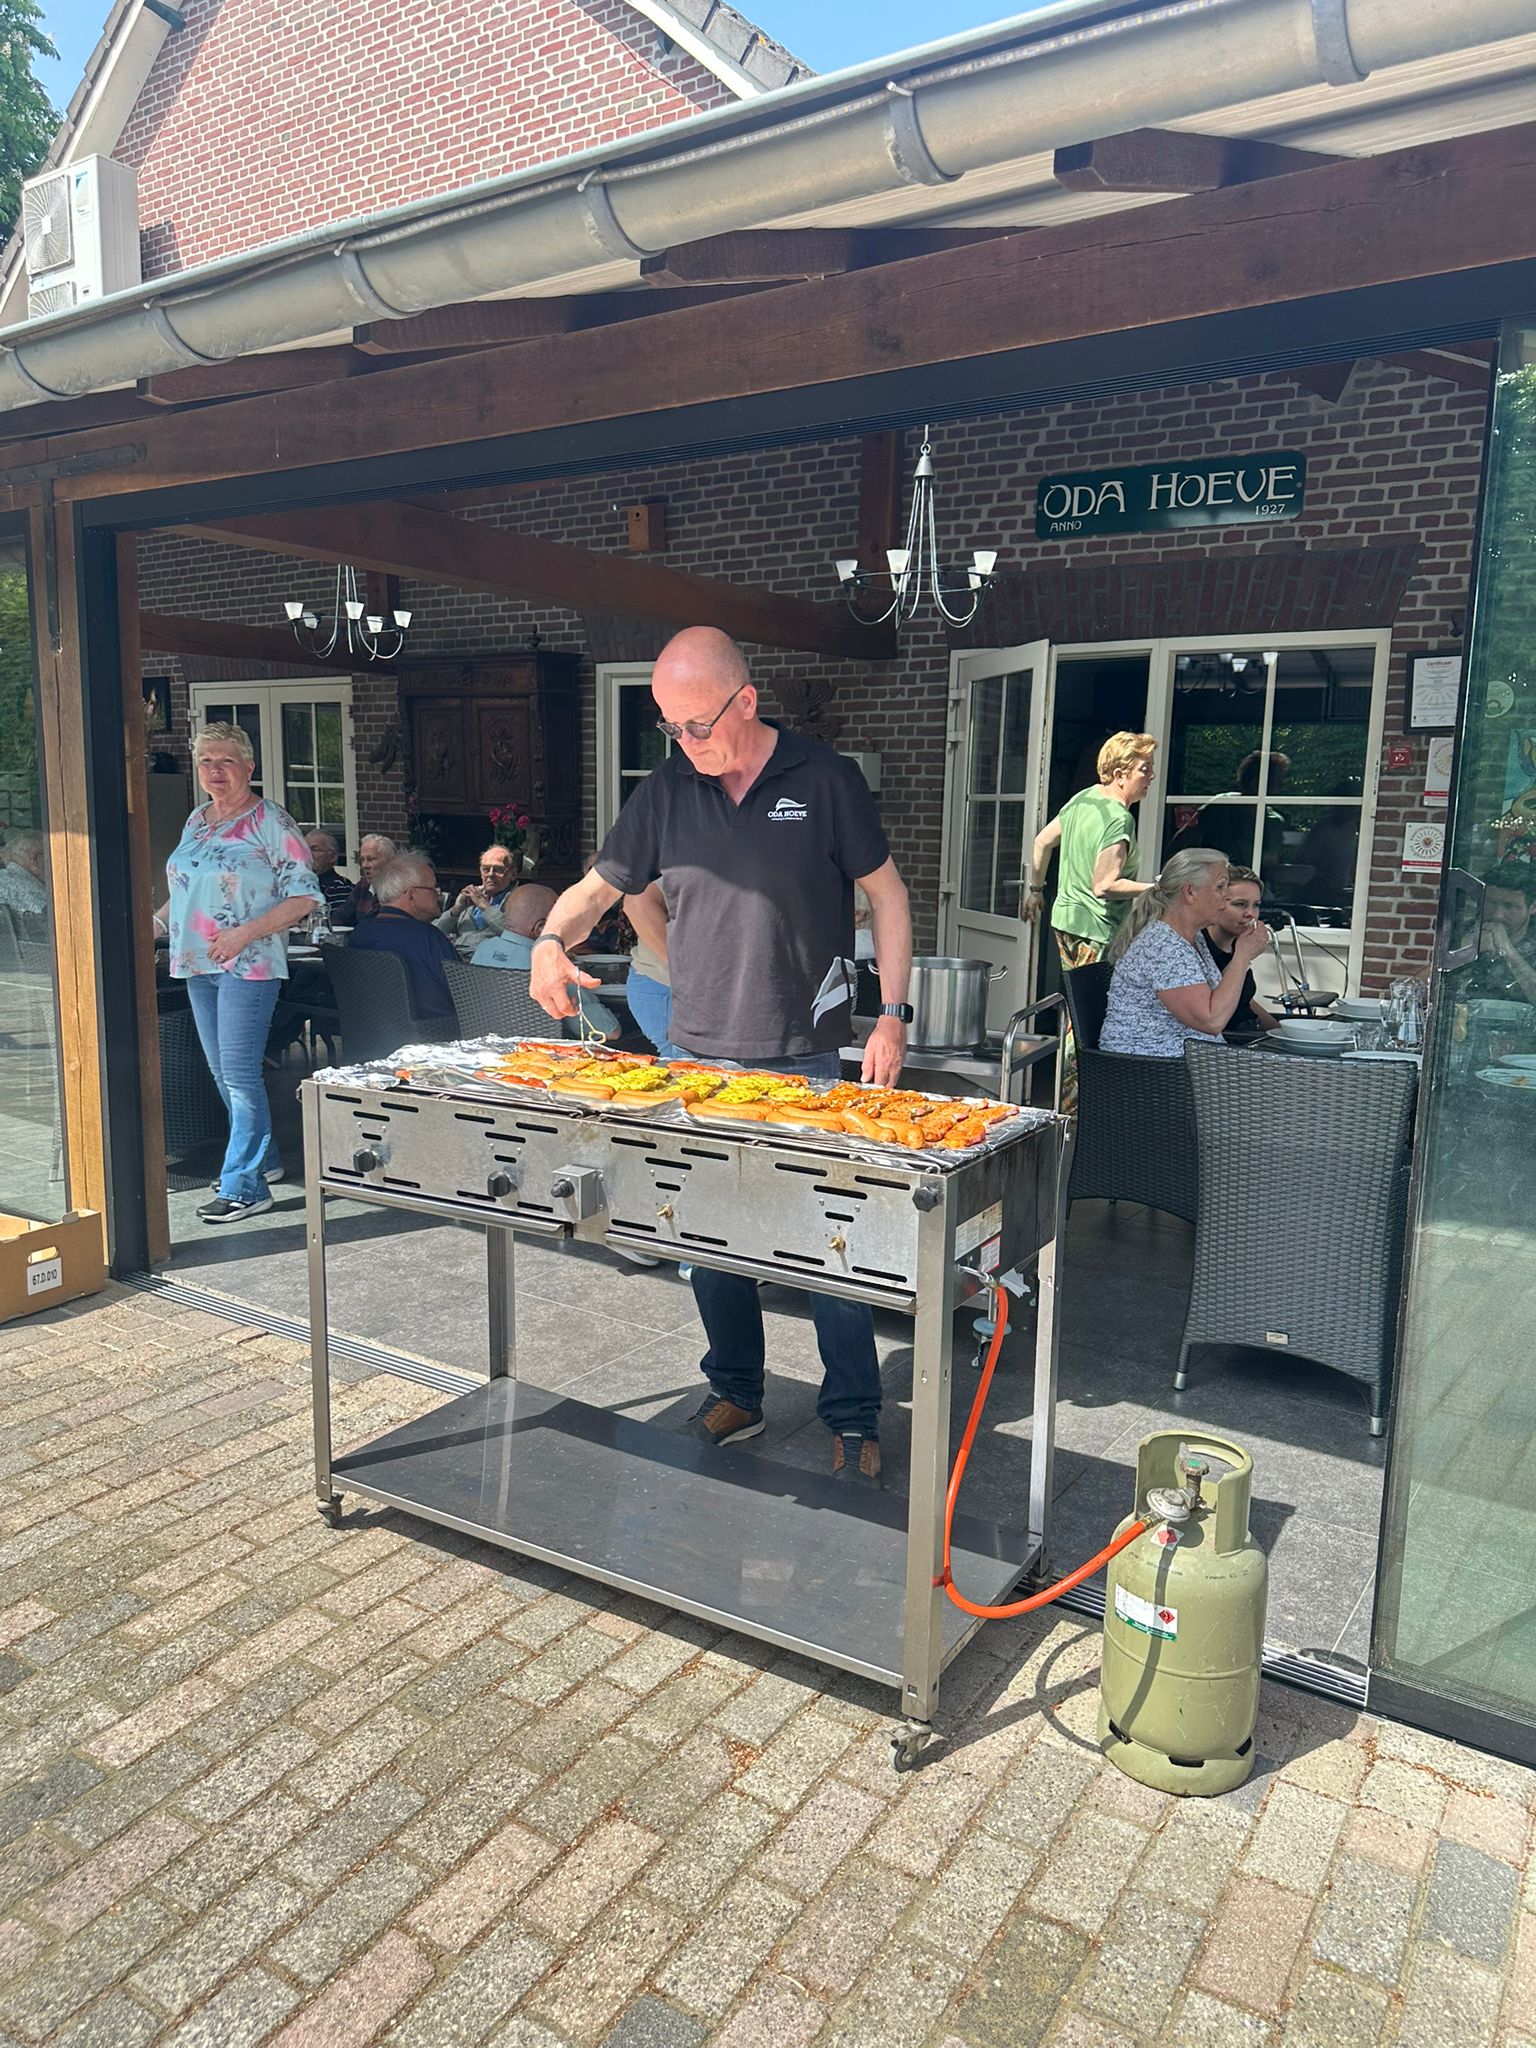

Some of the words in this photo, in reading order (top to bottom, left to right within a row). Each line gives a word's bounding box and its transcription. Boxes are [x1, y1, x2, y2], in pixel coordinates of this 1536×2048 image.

[1043, 480, 1126, 519] ODA
[1148, 465, 1297, 510] HOEVE
[1050, 520, 1082, 533] ANNO
[1255, 503, 1286, 515] 1927
